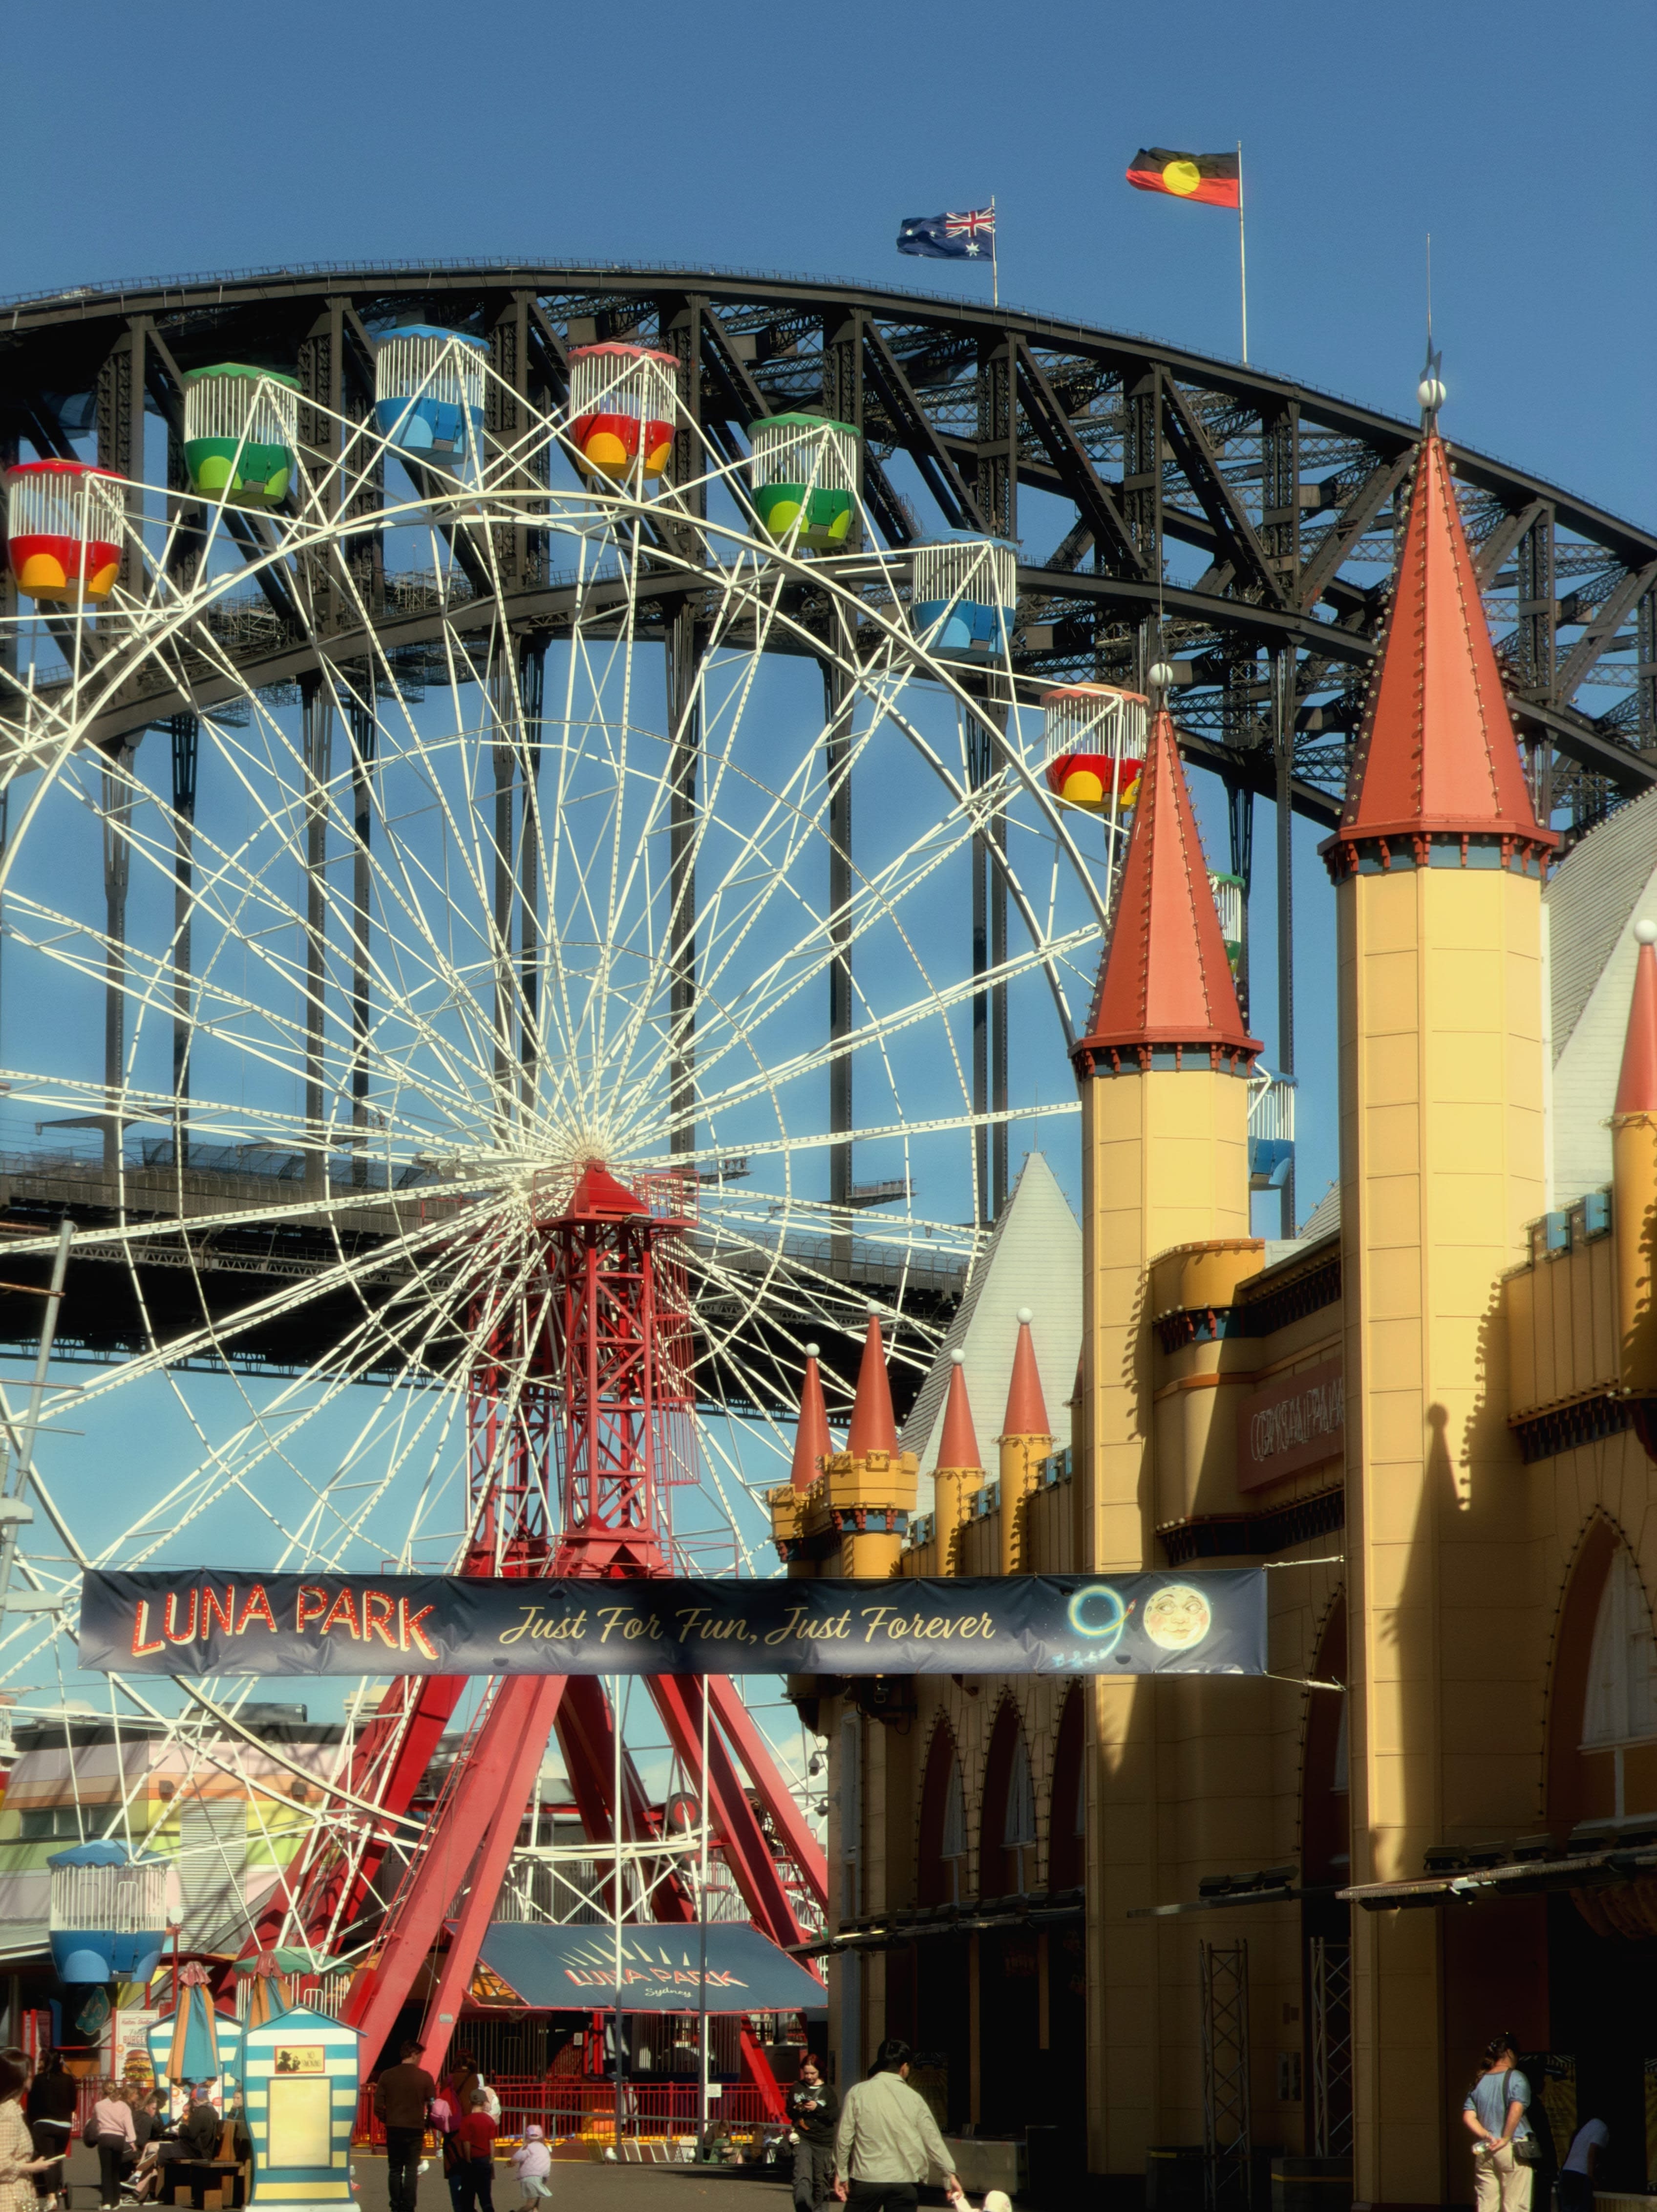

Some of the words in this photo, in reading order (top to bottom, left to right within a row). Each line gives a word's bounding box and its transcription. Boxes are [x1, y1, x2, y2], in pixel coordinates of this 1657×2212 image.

[130, 1584, 278, 1658] LUNA
[296, 1585, 439, 1660] PARK
[499, 1606, 587, 1645] Just
[596, 1606, 663, 1643] For
[676, 1608, 757, 1645] Fun,
[765, 1606, 851, 1645] Just
[861, 1606, 995, 1643] Forever
[564, 1968, 652, 1986] LUNA
[649, 1967, 749, 1988] PARK
[644, 1987, 694, 1998] Sydney
